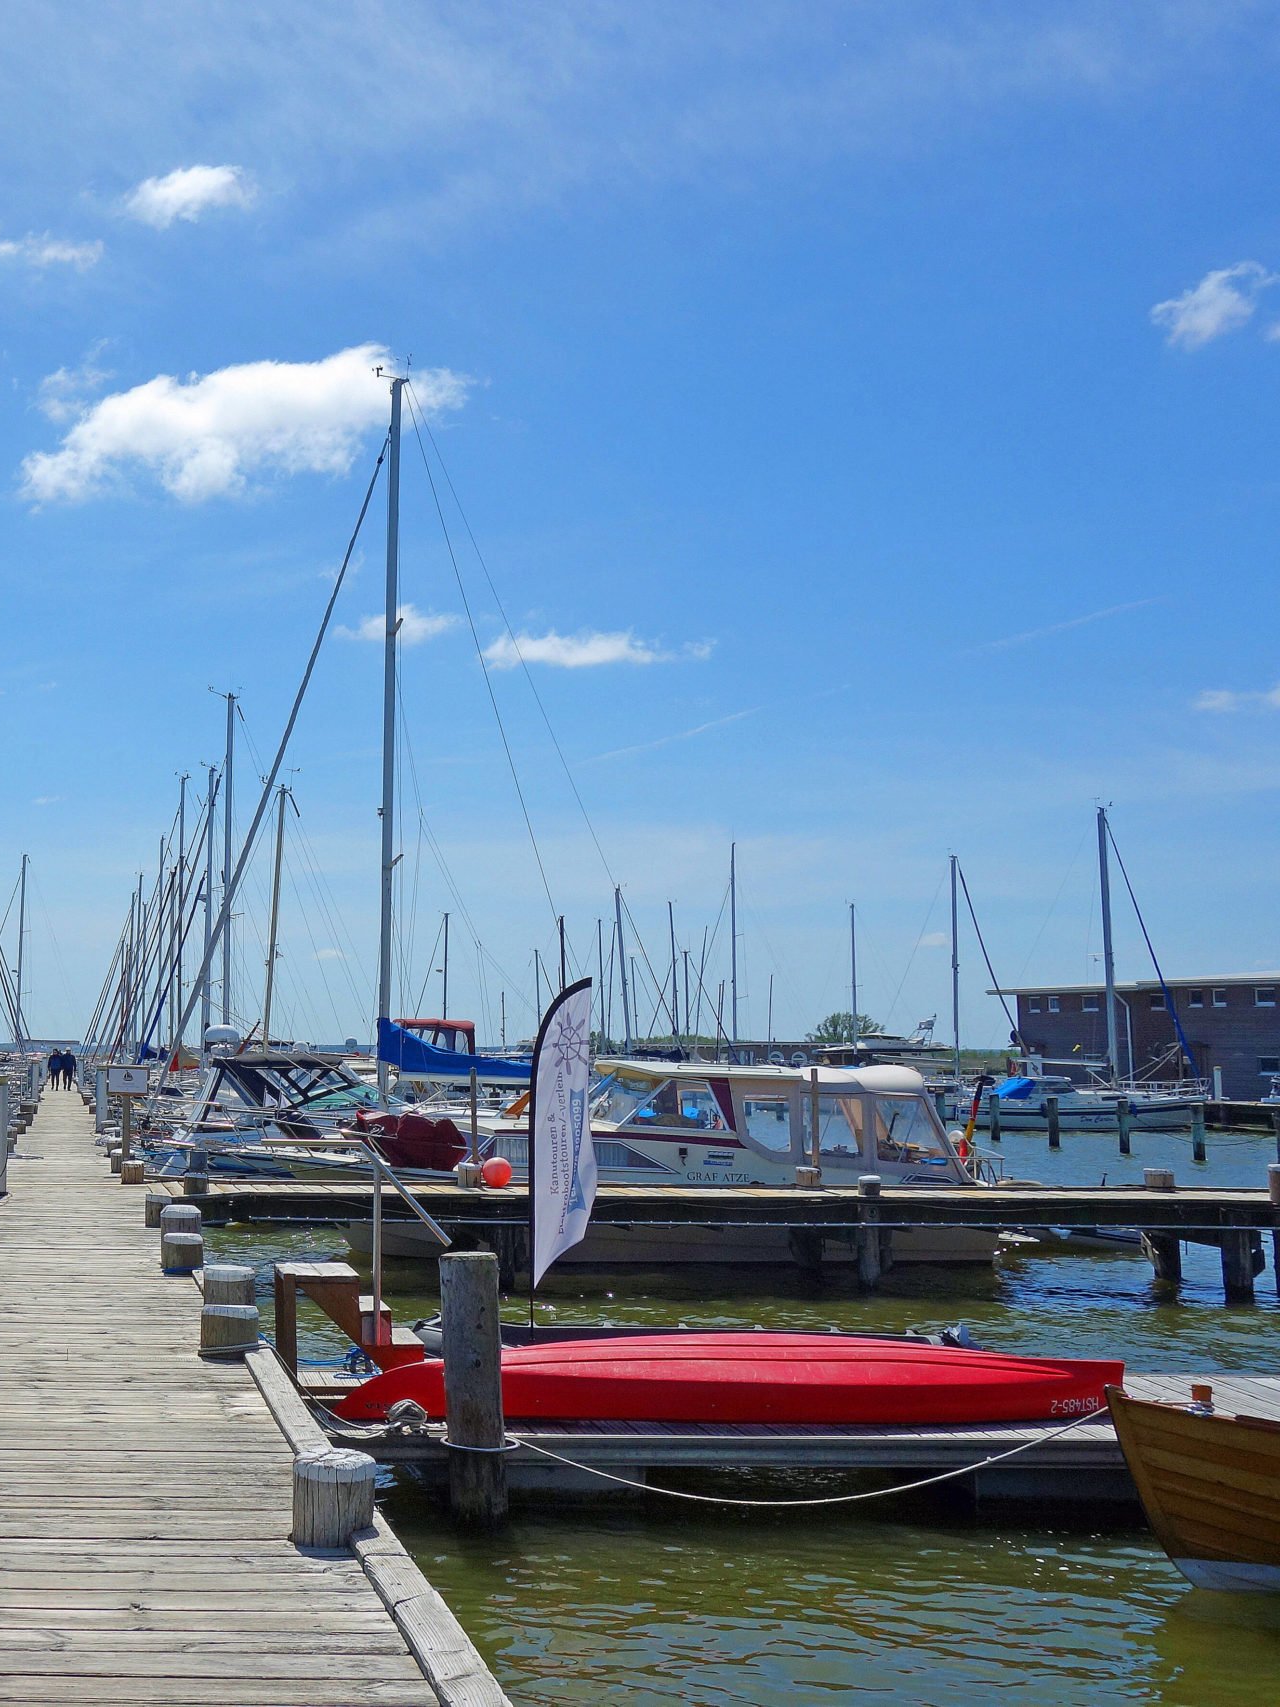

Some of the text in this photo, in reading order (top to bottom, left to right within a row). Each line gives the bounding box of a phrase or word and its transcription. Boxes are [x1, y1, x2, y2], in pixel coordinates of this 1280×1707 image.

[547, 1112, 559, 1195] Kanutouren &
[686, 1171, 750, 1183] GRAF ATZE
[1050, 1396, 1099, 1415] HST485-2
